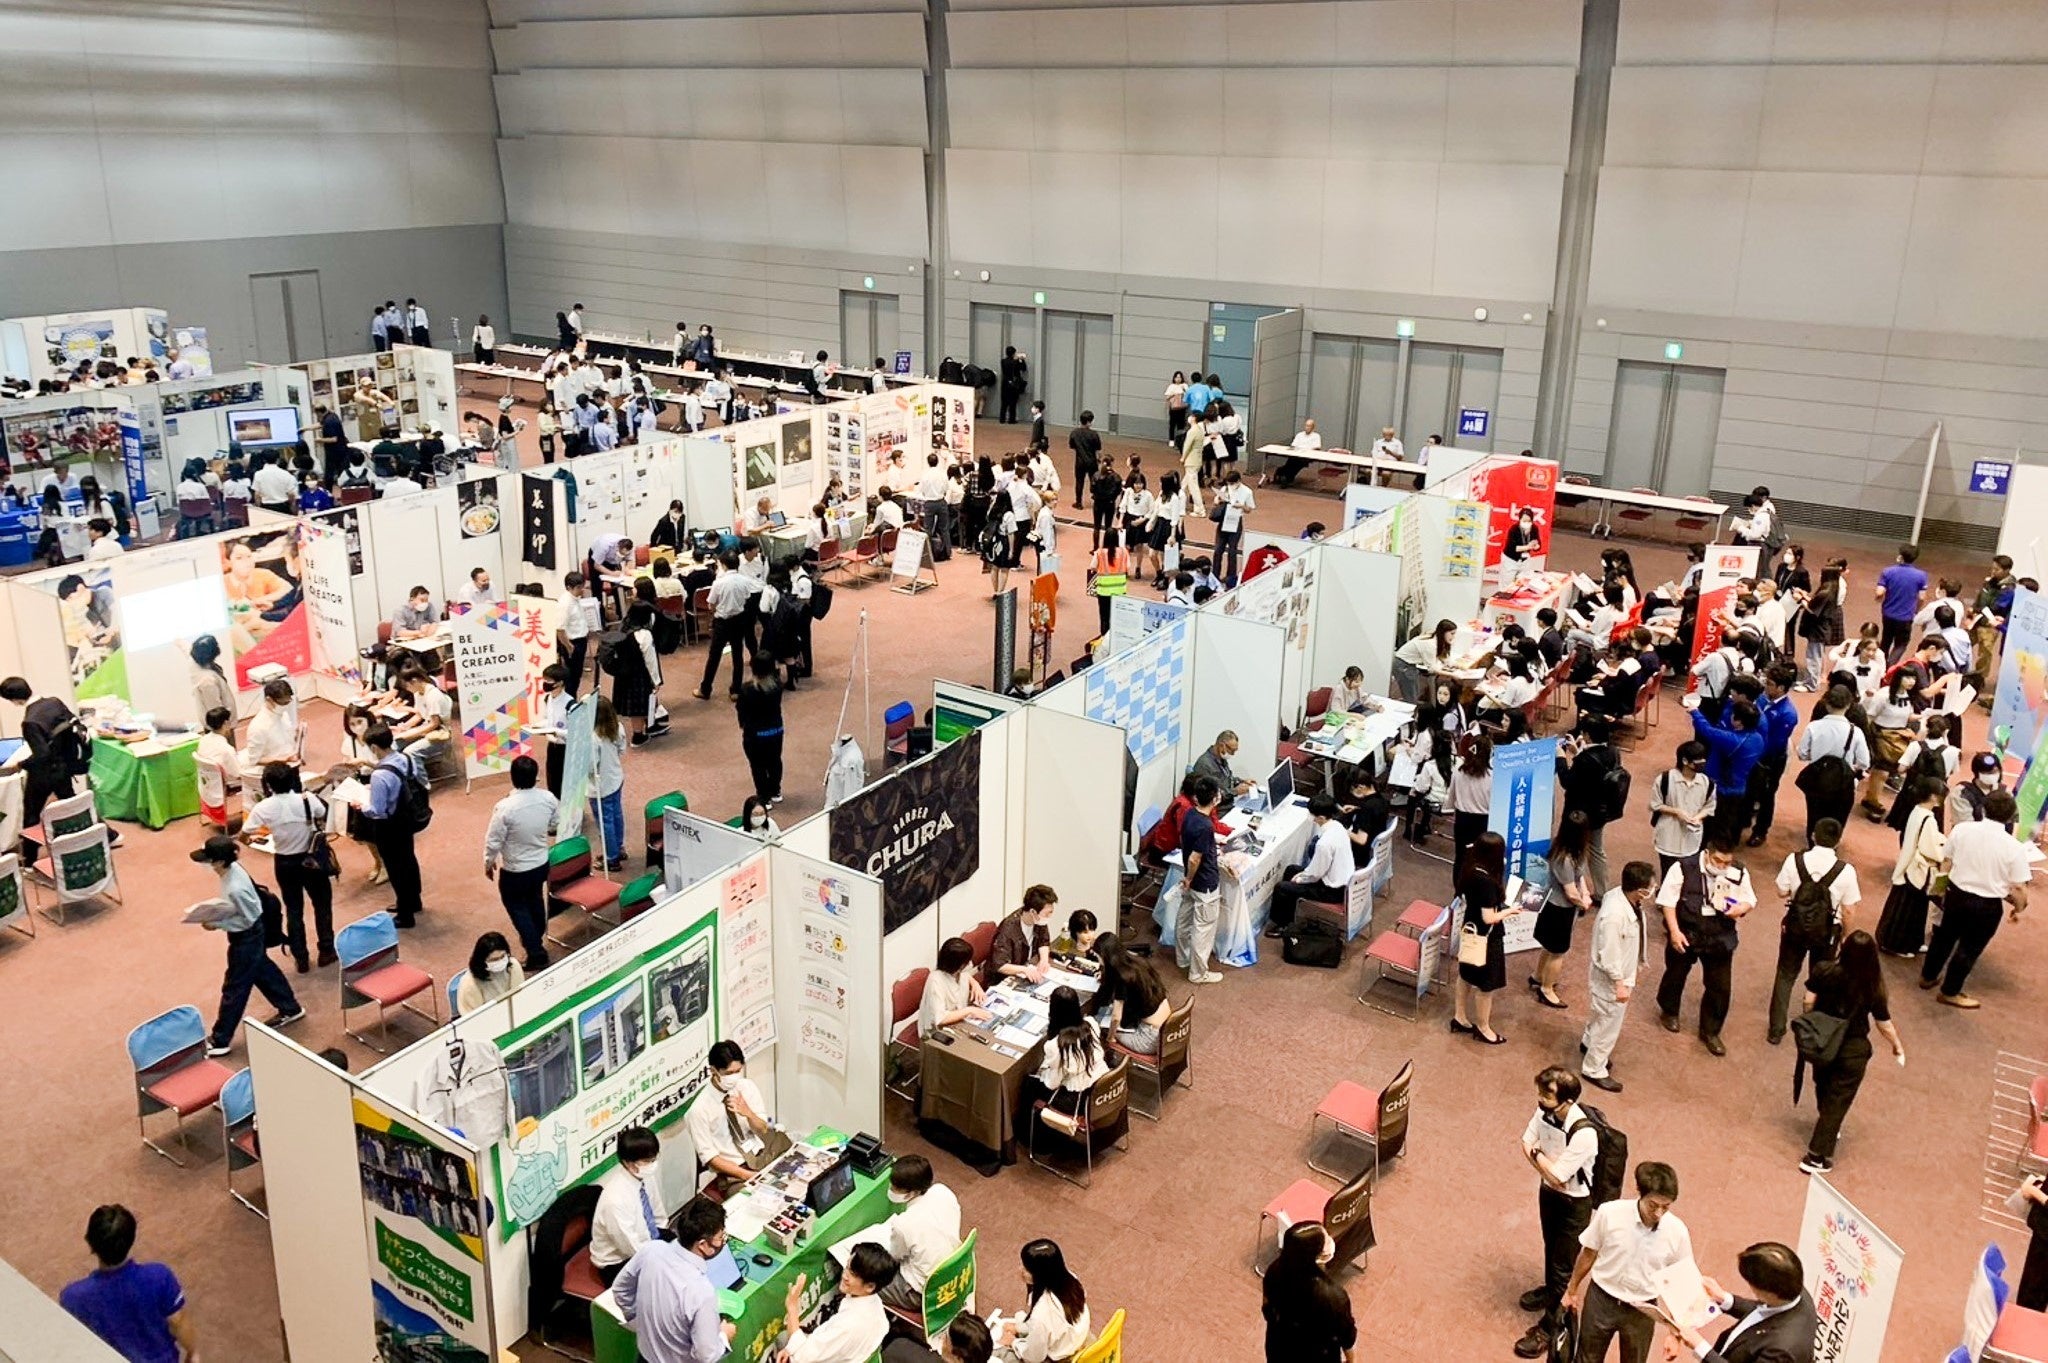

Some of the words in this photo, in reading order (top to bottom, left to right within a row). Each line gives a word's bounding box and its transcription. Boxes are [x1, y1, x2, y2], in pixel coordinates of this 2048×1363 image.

[459, 634, 473, 643] BE
[461, 647, 470, 656] A
[472, 644, 495, 655] LIFE
[461, 653, 516, 669] CREATOR
[892, 806, 929, 835] BARBER
[866, 810, 955, 878] CHURA
